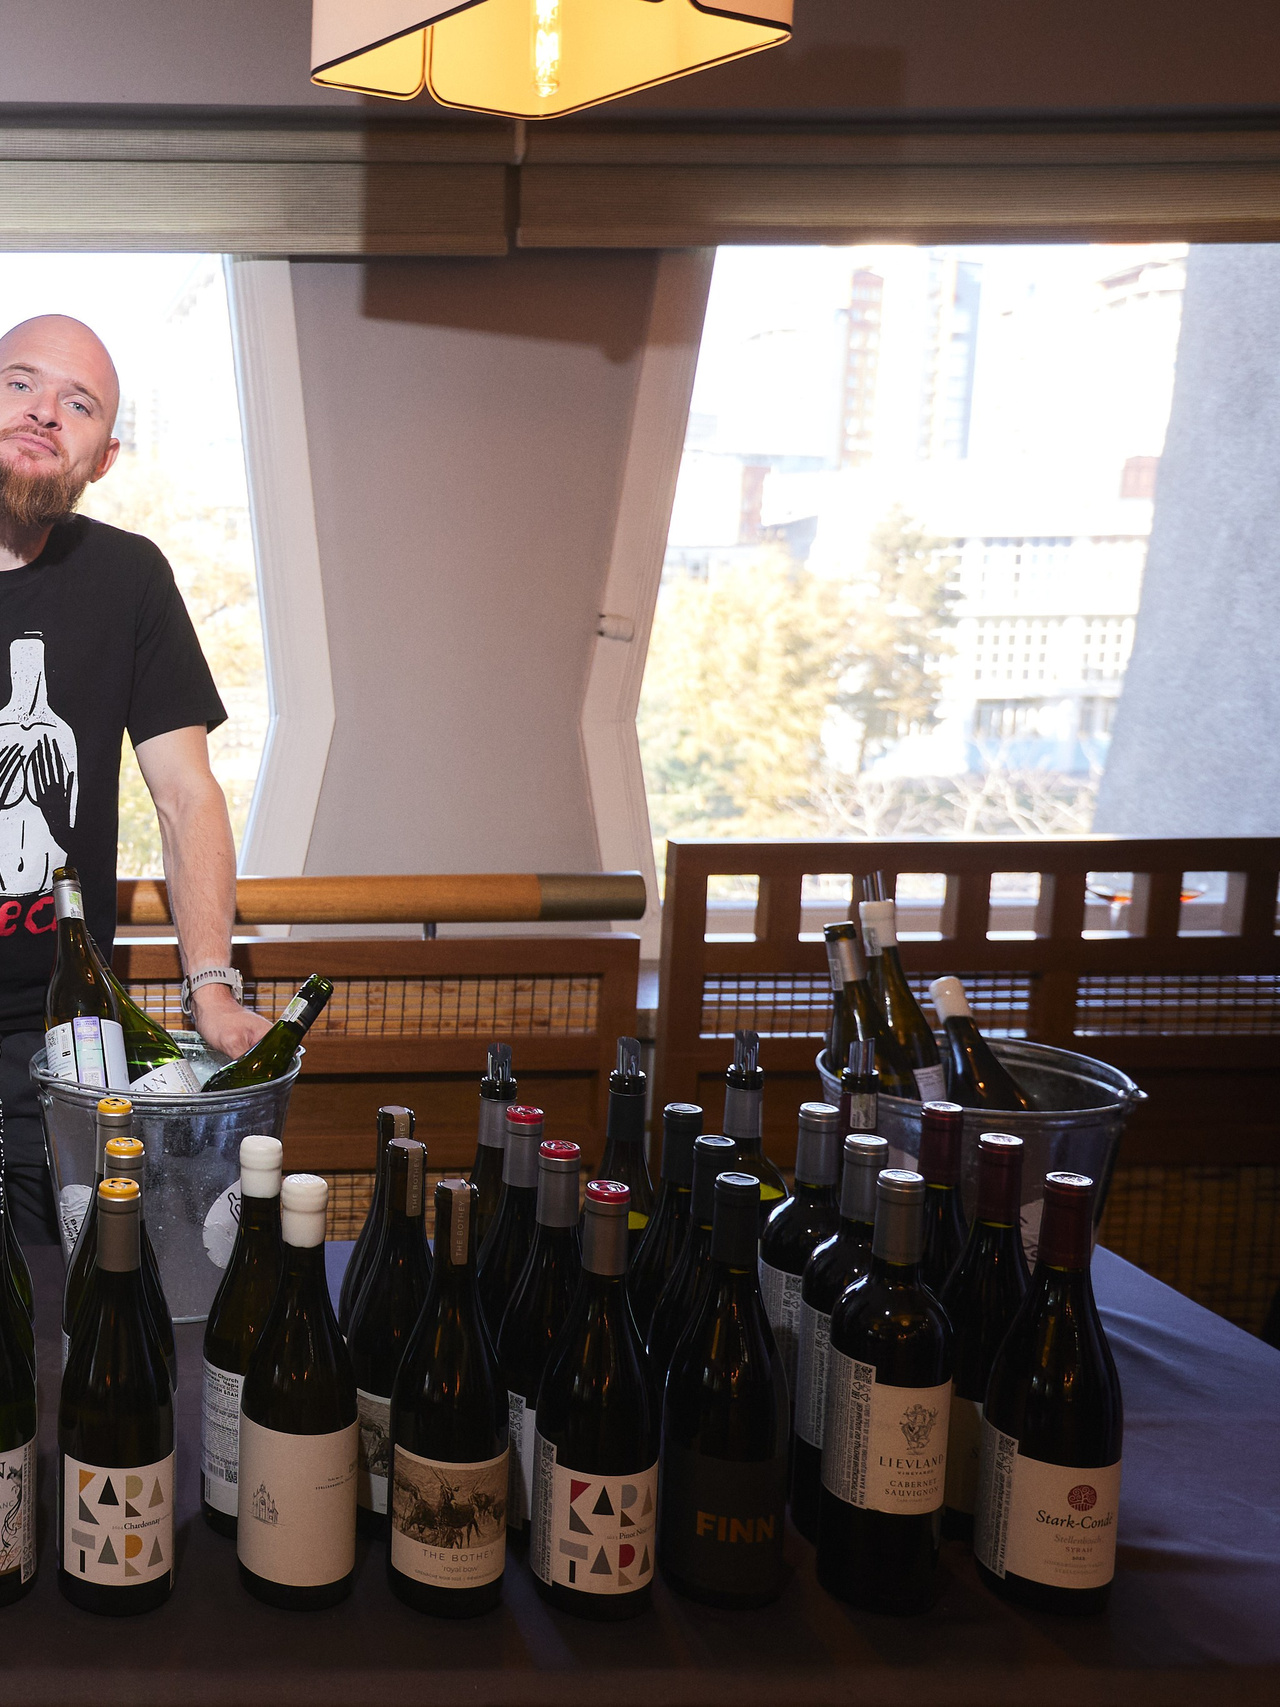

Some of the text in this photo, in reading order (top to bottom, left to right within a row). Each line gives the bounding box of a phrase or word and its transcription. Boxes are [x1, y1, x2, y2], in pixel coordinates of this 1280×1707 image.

[456, 1200, 465, 1256] THE BOTHEY
[879, 1454, 943, 1469] LIEVLAND
[79, 1469, 164, 1525] KARA
[884, 1486, 939, 1497] SAUVIGNON
[889, 1478, 937, 1488] CABERNET
[124, 1517, 161, 1530] Chardonnay
[570, 1479, 653, 1535] KARA
[696, 1510, 775, 1543] FINN
[72, 1528, 164, 1578] TARA
[422, 1548, 495, 1562] THE BOTHEY
[559, 1538, 651, 1587] TARA
